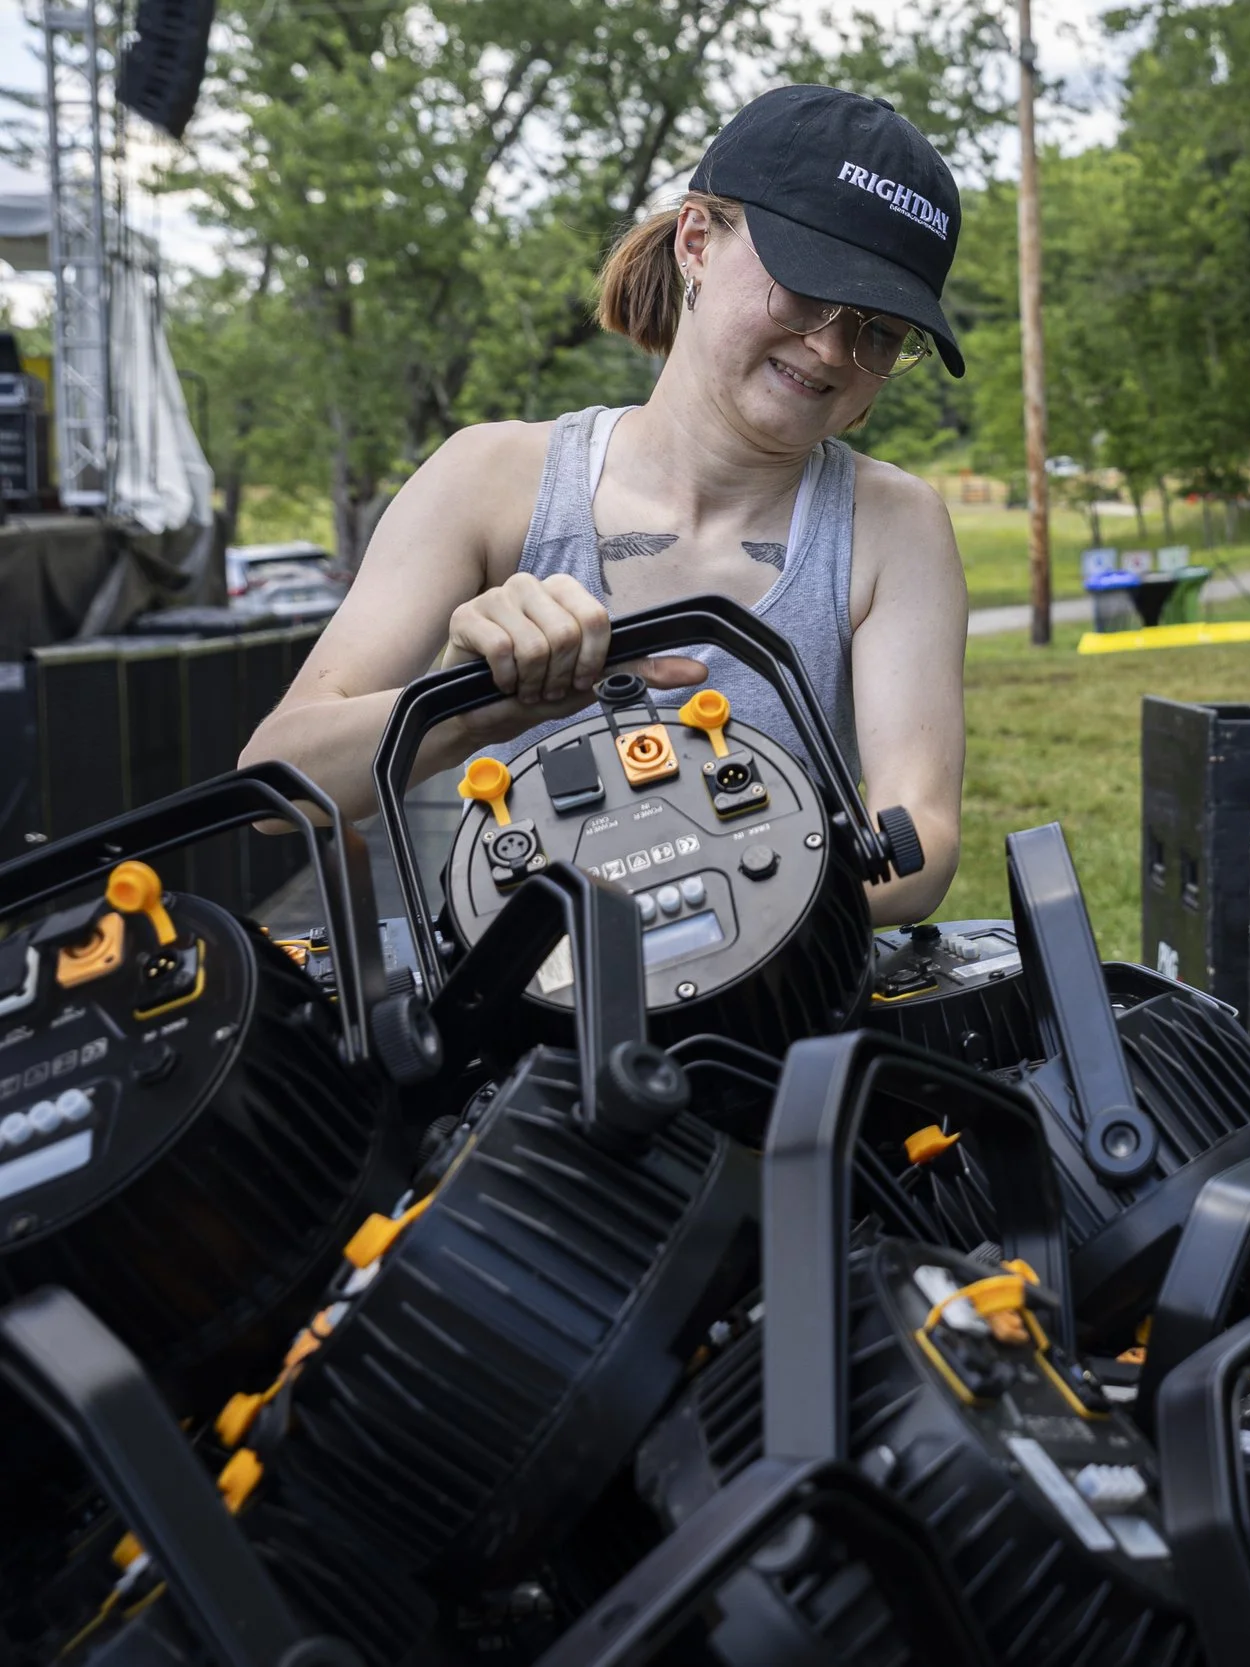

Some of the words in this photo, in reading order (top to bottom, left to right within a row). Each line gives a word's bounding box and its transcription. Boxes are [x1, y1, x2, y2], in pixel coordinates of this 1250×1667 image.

[837, 161, 950, 235] FRIGHTDAY
[632, 805, 663, 820] POWER
[585, 820, 618, 836] POWER
